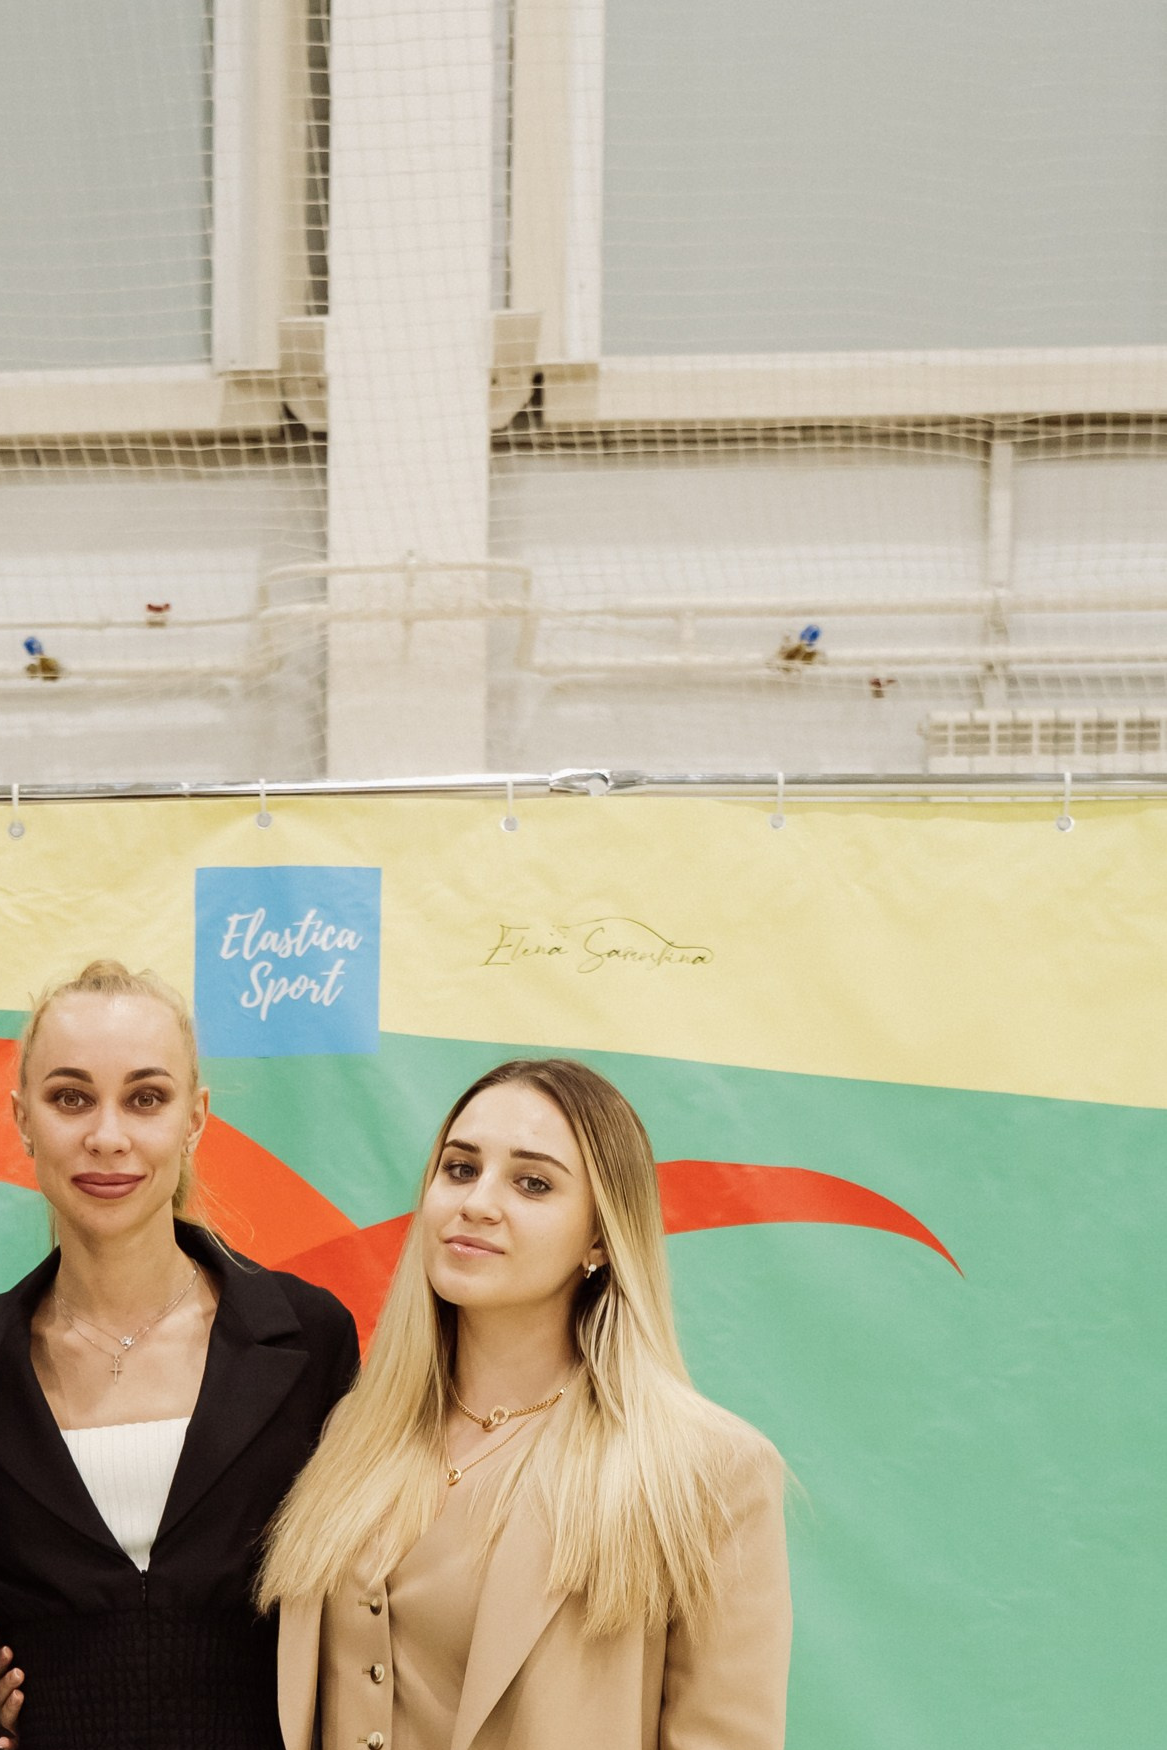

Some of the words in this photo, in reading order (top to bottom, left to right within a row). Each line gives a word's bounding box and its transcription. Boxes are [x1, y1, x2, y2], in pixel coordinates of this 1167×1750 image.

[219, 907, 363, 961] Elastica
[478, 923, 568, 967] Elena
[240, 958, 346, 1022] Sport
